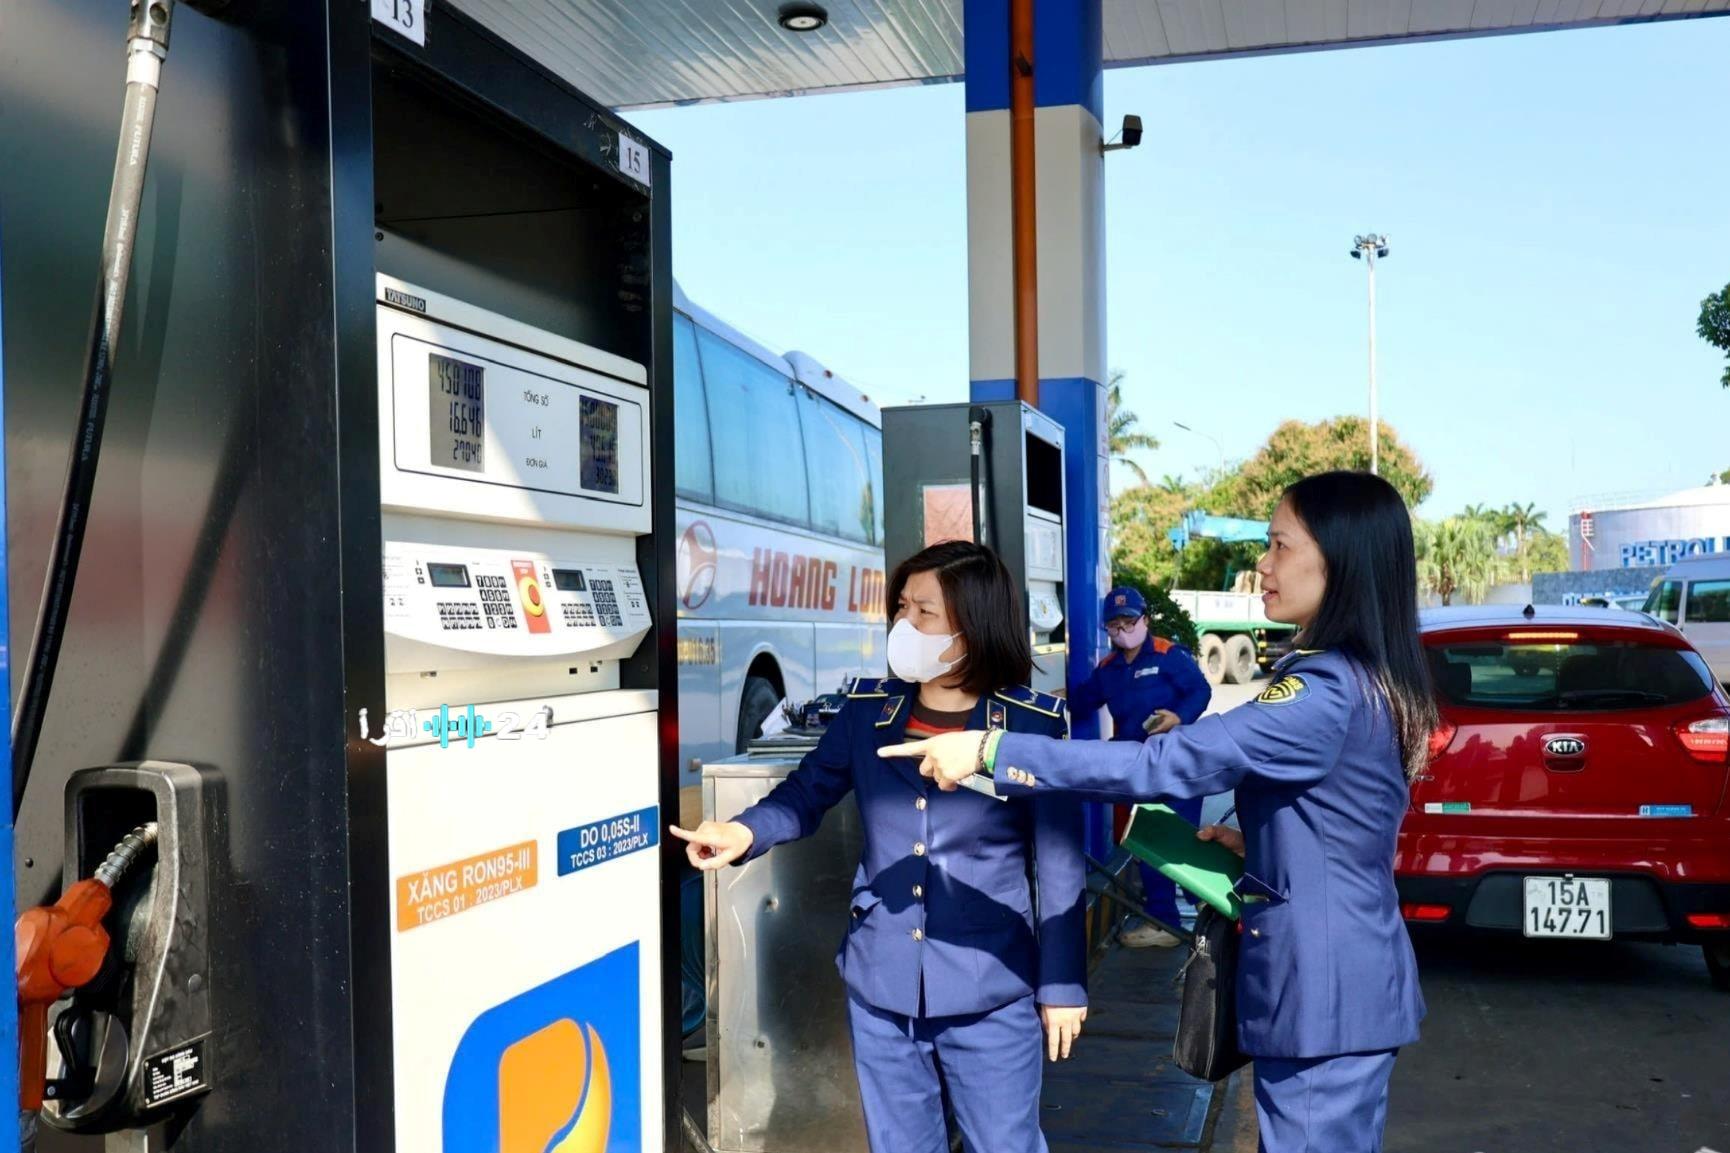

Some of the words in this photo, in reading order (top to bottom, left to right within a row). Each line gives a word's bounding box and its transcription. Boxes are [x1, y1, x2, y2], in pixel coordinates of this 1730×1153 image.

[392, 0, 413, 28] 13
[627, 147, 641, 173] 15
[386, 289, 425, 310] TATSUNO
[748, 546, 837, 611] HOANG
[1552, 741, 1579, 752] KIA
[580, 826, 598, 848] DO
[601, 814, 640, 843] 0,05S-II
[571, 848, 595, 868] TCCS
[596, 845, 607, 861] 03
[613, 833, 648, 855] 2023/PLX
[408, 872, 458, 906] XĂNG
[463, 847, 530, 888] RON95-III
[417, 898, 451, 924] TCCS
[453, 893, 466, 913] 01
[476, 875, 523, 905] 2023/PLX
[1548, 882, 1589, 906] 15A
[1530, 907, 1605, 934] 147.71
